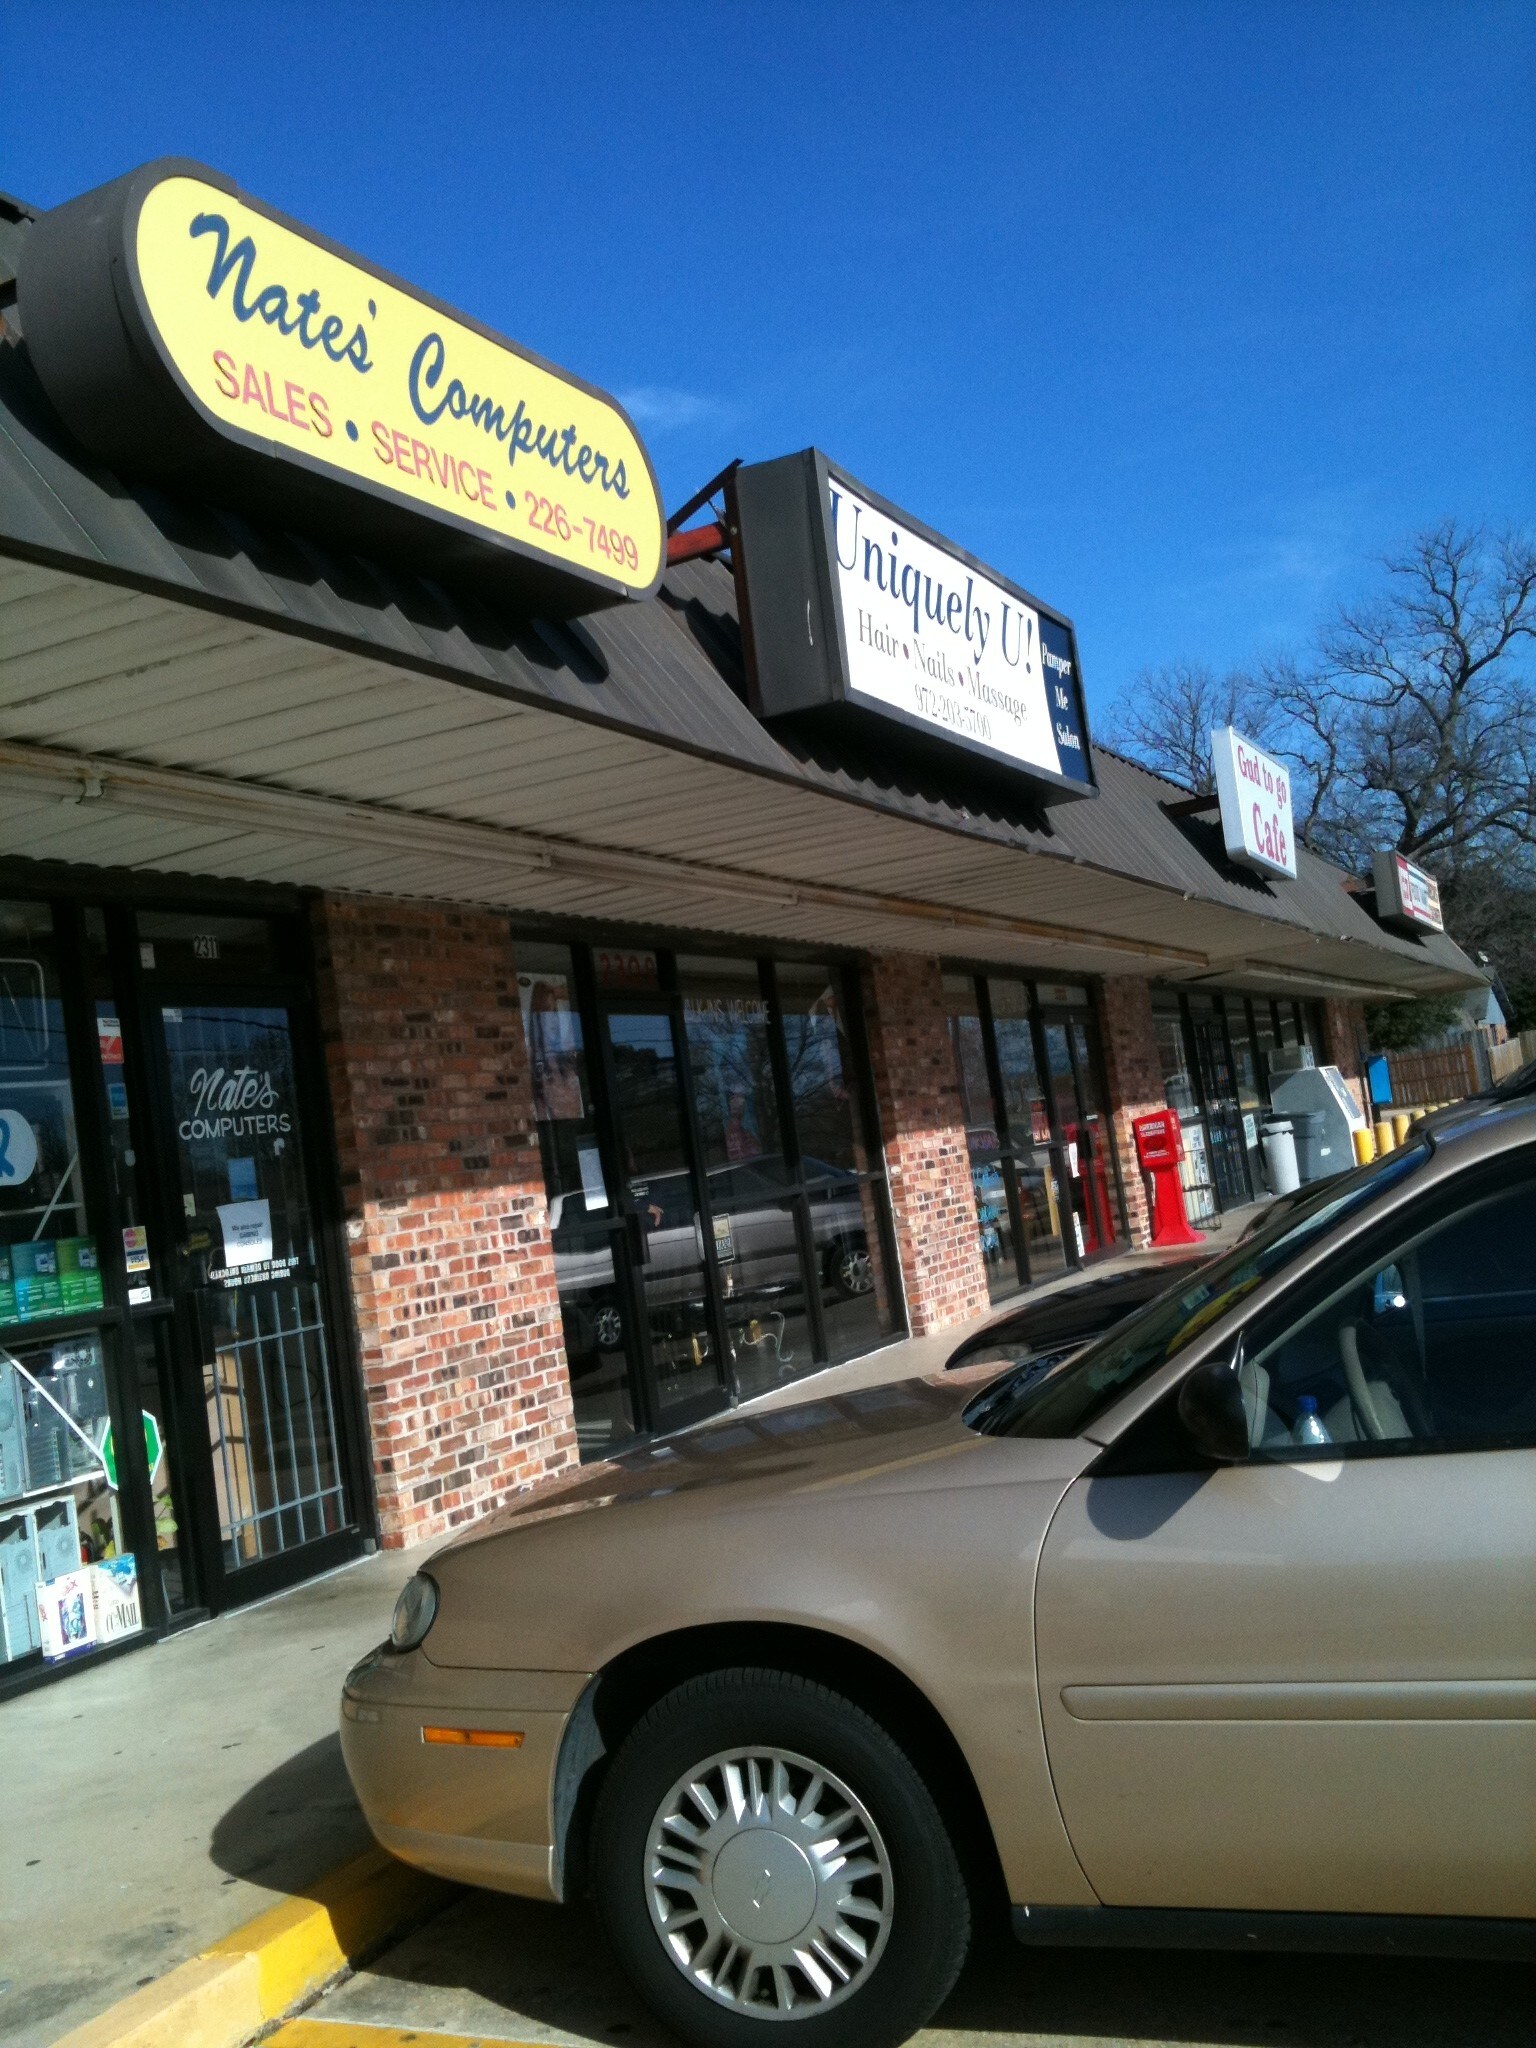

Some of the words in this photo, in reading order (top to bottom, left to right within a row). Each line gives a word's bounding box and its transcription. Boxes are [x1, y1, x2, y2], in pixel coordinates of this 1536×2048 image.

[408, 332, 631, 501] Computers
[213, 350, 333, 438] SALES
[372, 421, 498, 511] SERVICE
[524, 491, 639, 571] 226-7499
[829, 487, 990, 666] Uniquely
[1001, 601, 1032, 674] U!
[858, 608, 899, 658] Hair
[913, 638, 955, 687] Nails
[967, 666, 1028, 727] Massage
[1042, 642, 1072, 679] Pamper
[1055, 685, 1069, 711] Me
[1056, 722, 1081, 750] Salon
[1262, 763, 1274, 795] to
[1276, 775, 1287, 810] go
[1252, 802, 1287, 866] Cafe
[193, 935, 218, 958] 2311
[190, 1065, 279, 1117] Nate's
[179, 1113, 291, 1141] COMPUTERS
